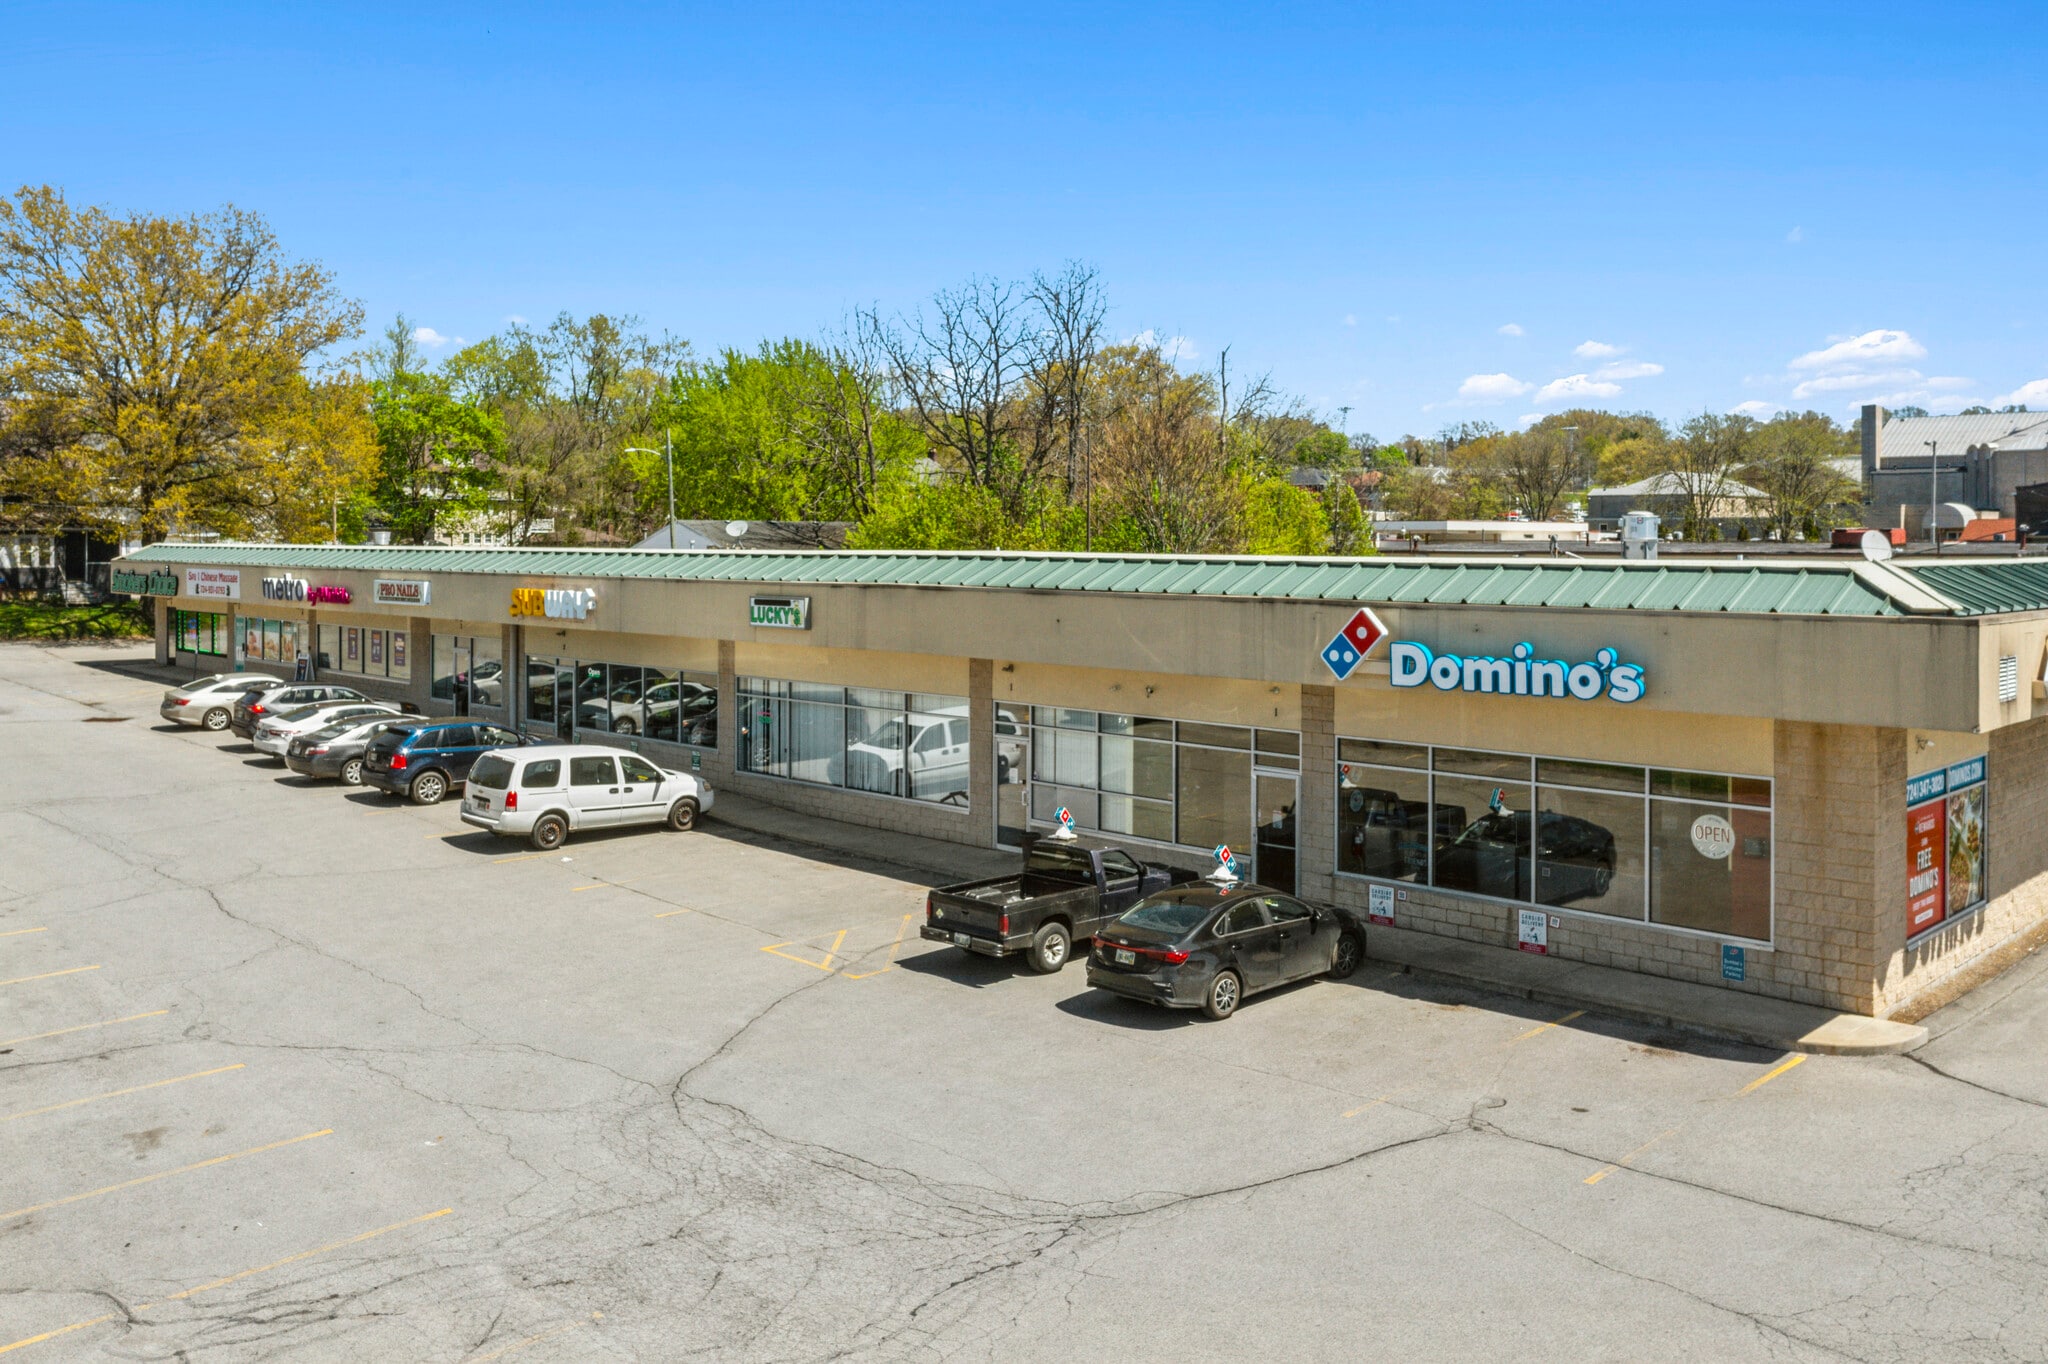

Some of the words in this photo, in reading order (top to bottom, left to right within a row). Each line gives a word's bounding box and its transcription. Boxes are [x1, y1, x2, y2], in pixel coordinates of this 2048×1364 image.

[112, 569, 148, 594] Smokers
[149, 565, 178, 597] Choice
[262, 573, 308, 601] metro
[380, 583, 396, 597] PRO
[396, 584, 419, 598] NAILS
[1390, 641, 1646, 703] Domino's
[1694, 824, 1730, 844] OPEN
[1917, 847, 1932, 871] FREE
[1909, 866, 1939, 898] DOMINO'S
